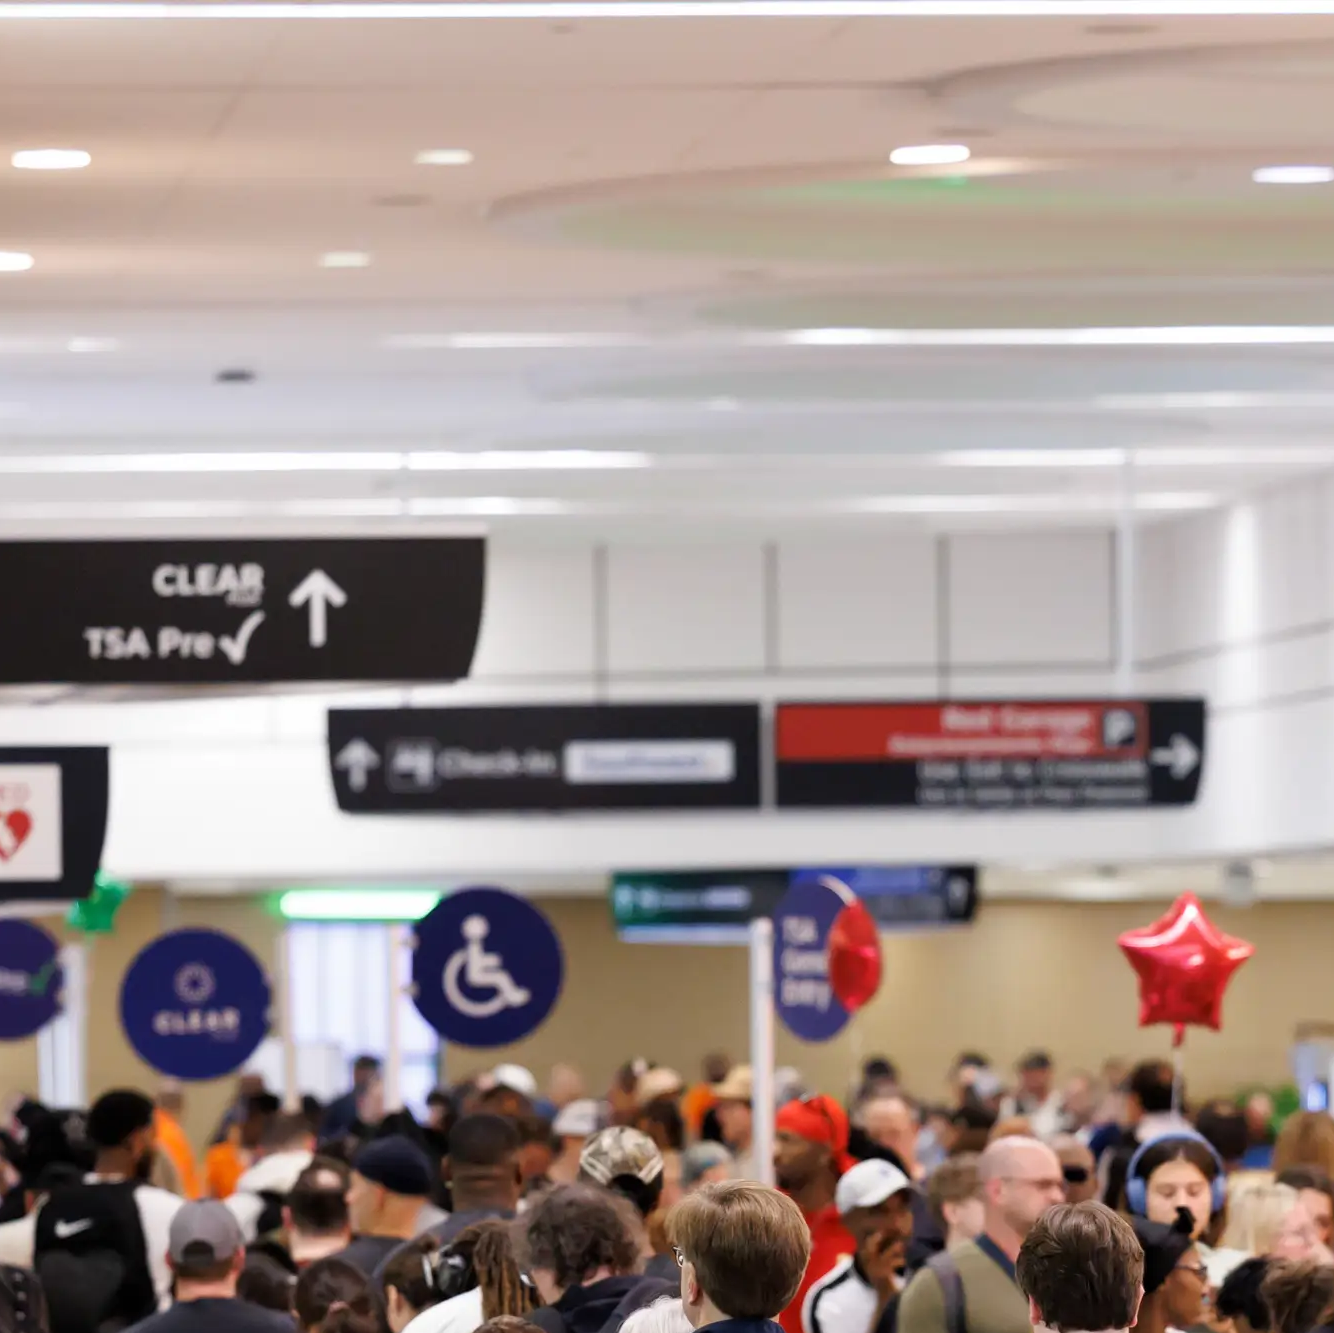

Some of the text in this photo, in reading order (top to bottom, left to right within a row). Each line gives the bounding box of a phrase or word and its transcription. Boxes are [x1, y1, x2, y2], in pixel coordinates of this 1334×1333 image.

[152, 563, 265, 597] CLEAR
[82, 626, 216, 660] TSA Pre
[153, 1007, 240, 1034] CLEAR
